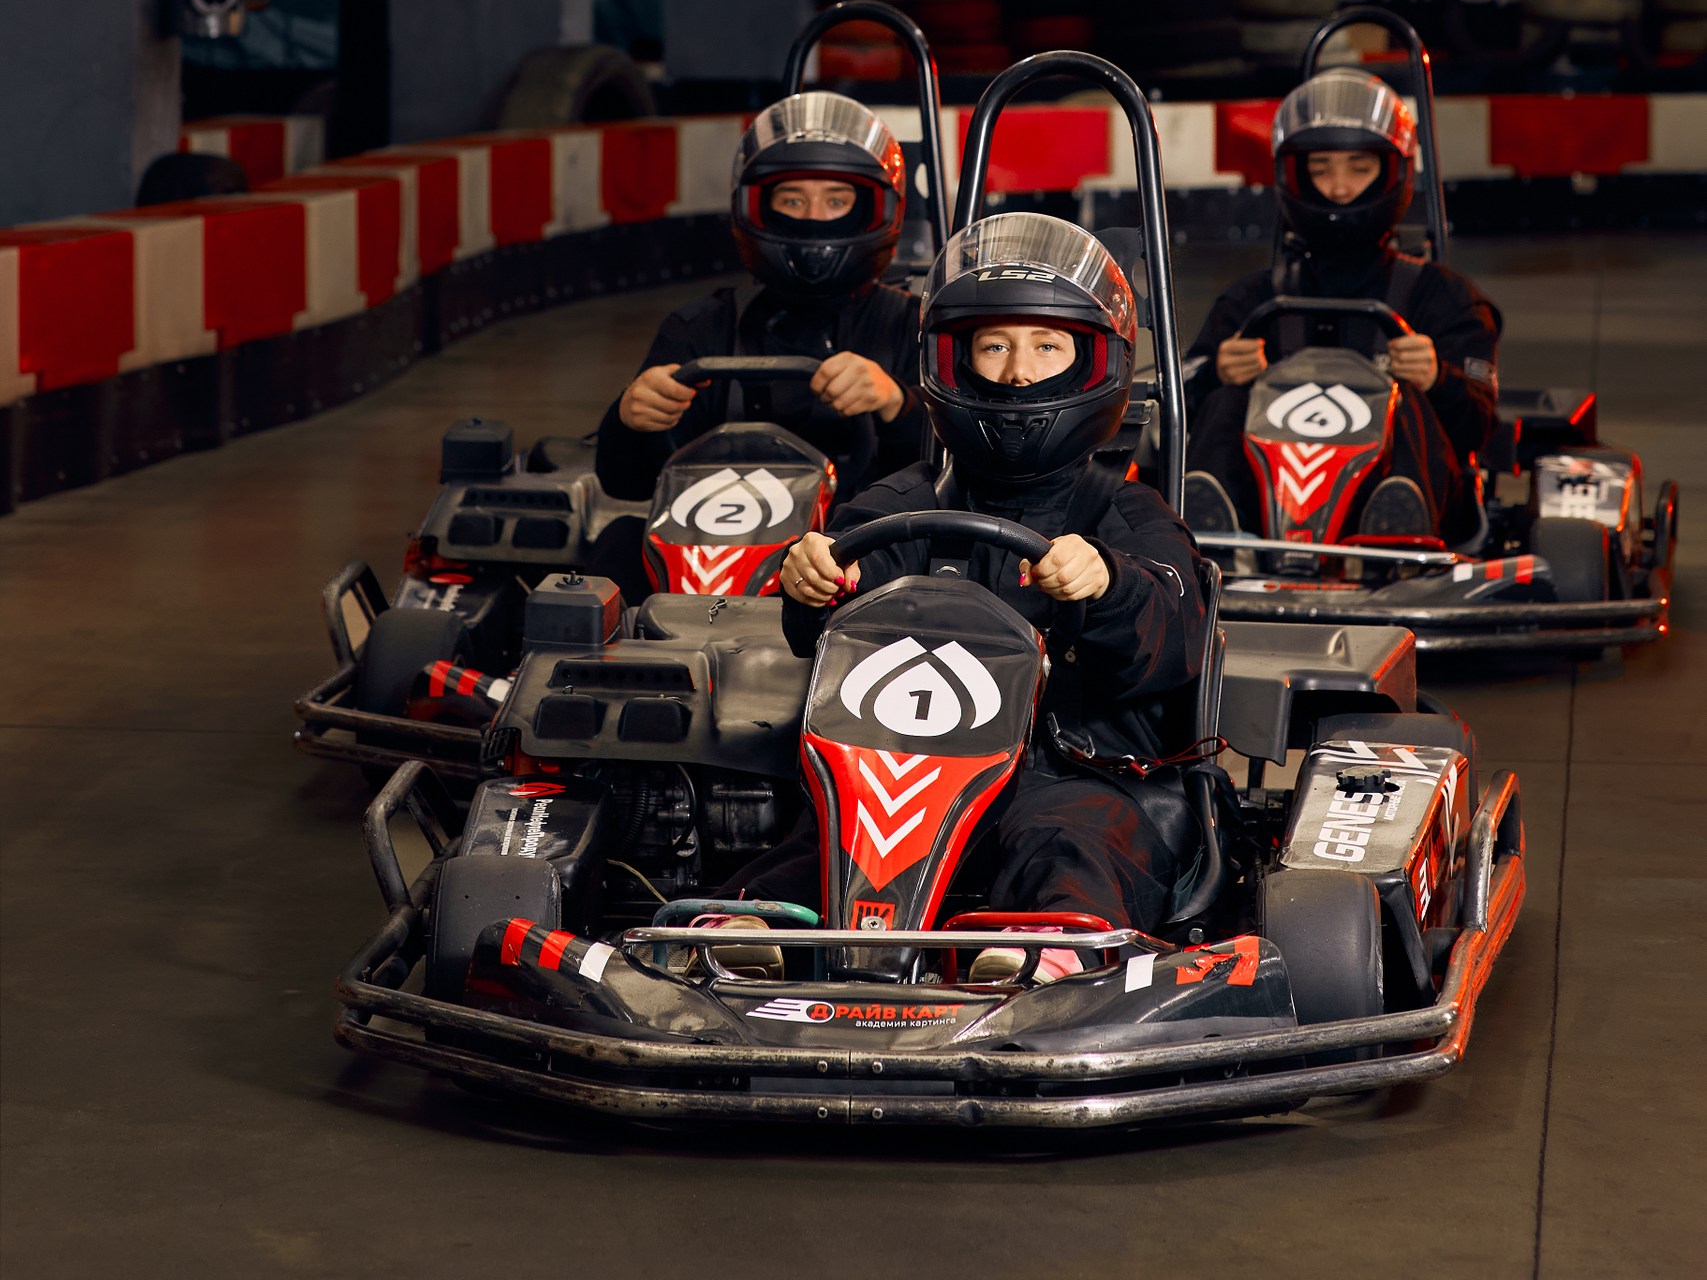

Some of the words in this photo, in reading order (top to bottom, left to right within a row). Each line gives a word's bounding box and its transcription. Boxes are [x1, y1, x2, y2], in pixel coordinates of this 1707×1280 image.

[978, 270, 1056, 284] LS2
[714, 504, 746, 524] 2
[908, 689, 933, 721] 1
[518, 798, 554, 859] РеалНефтеПроду
[811, 1004, 897, 1020] ДРАЙВ
[902, 1004, 965, 1019] КАРТ
[855, 1019, 907, 1029] академия
[909, 1016, 957, 1028] картинга
